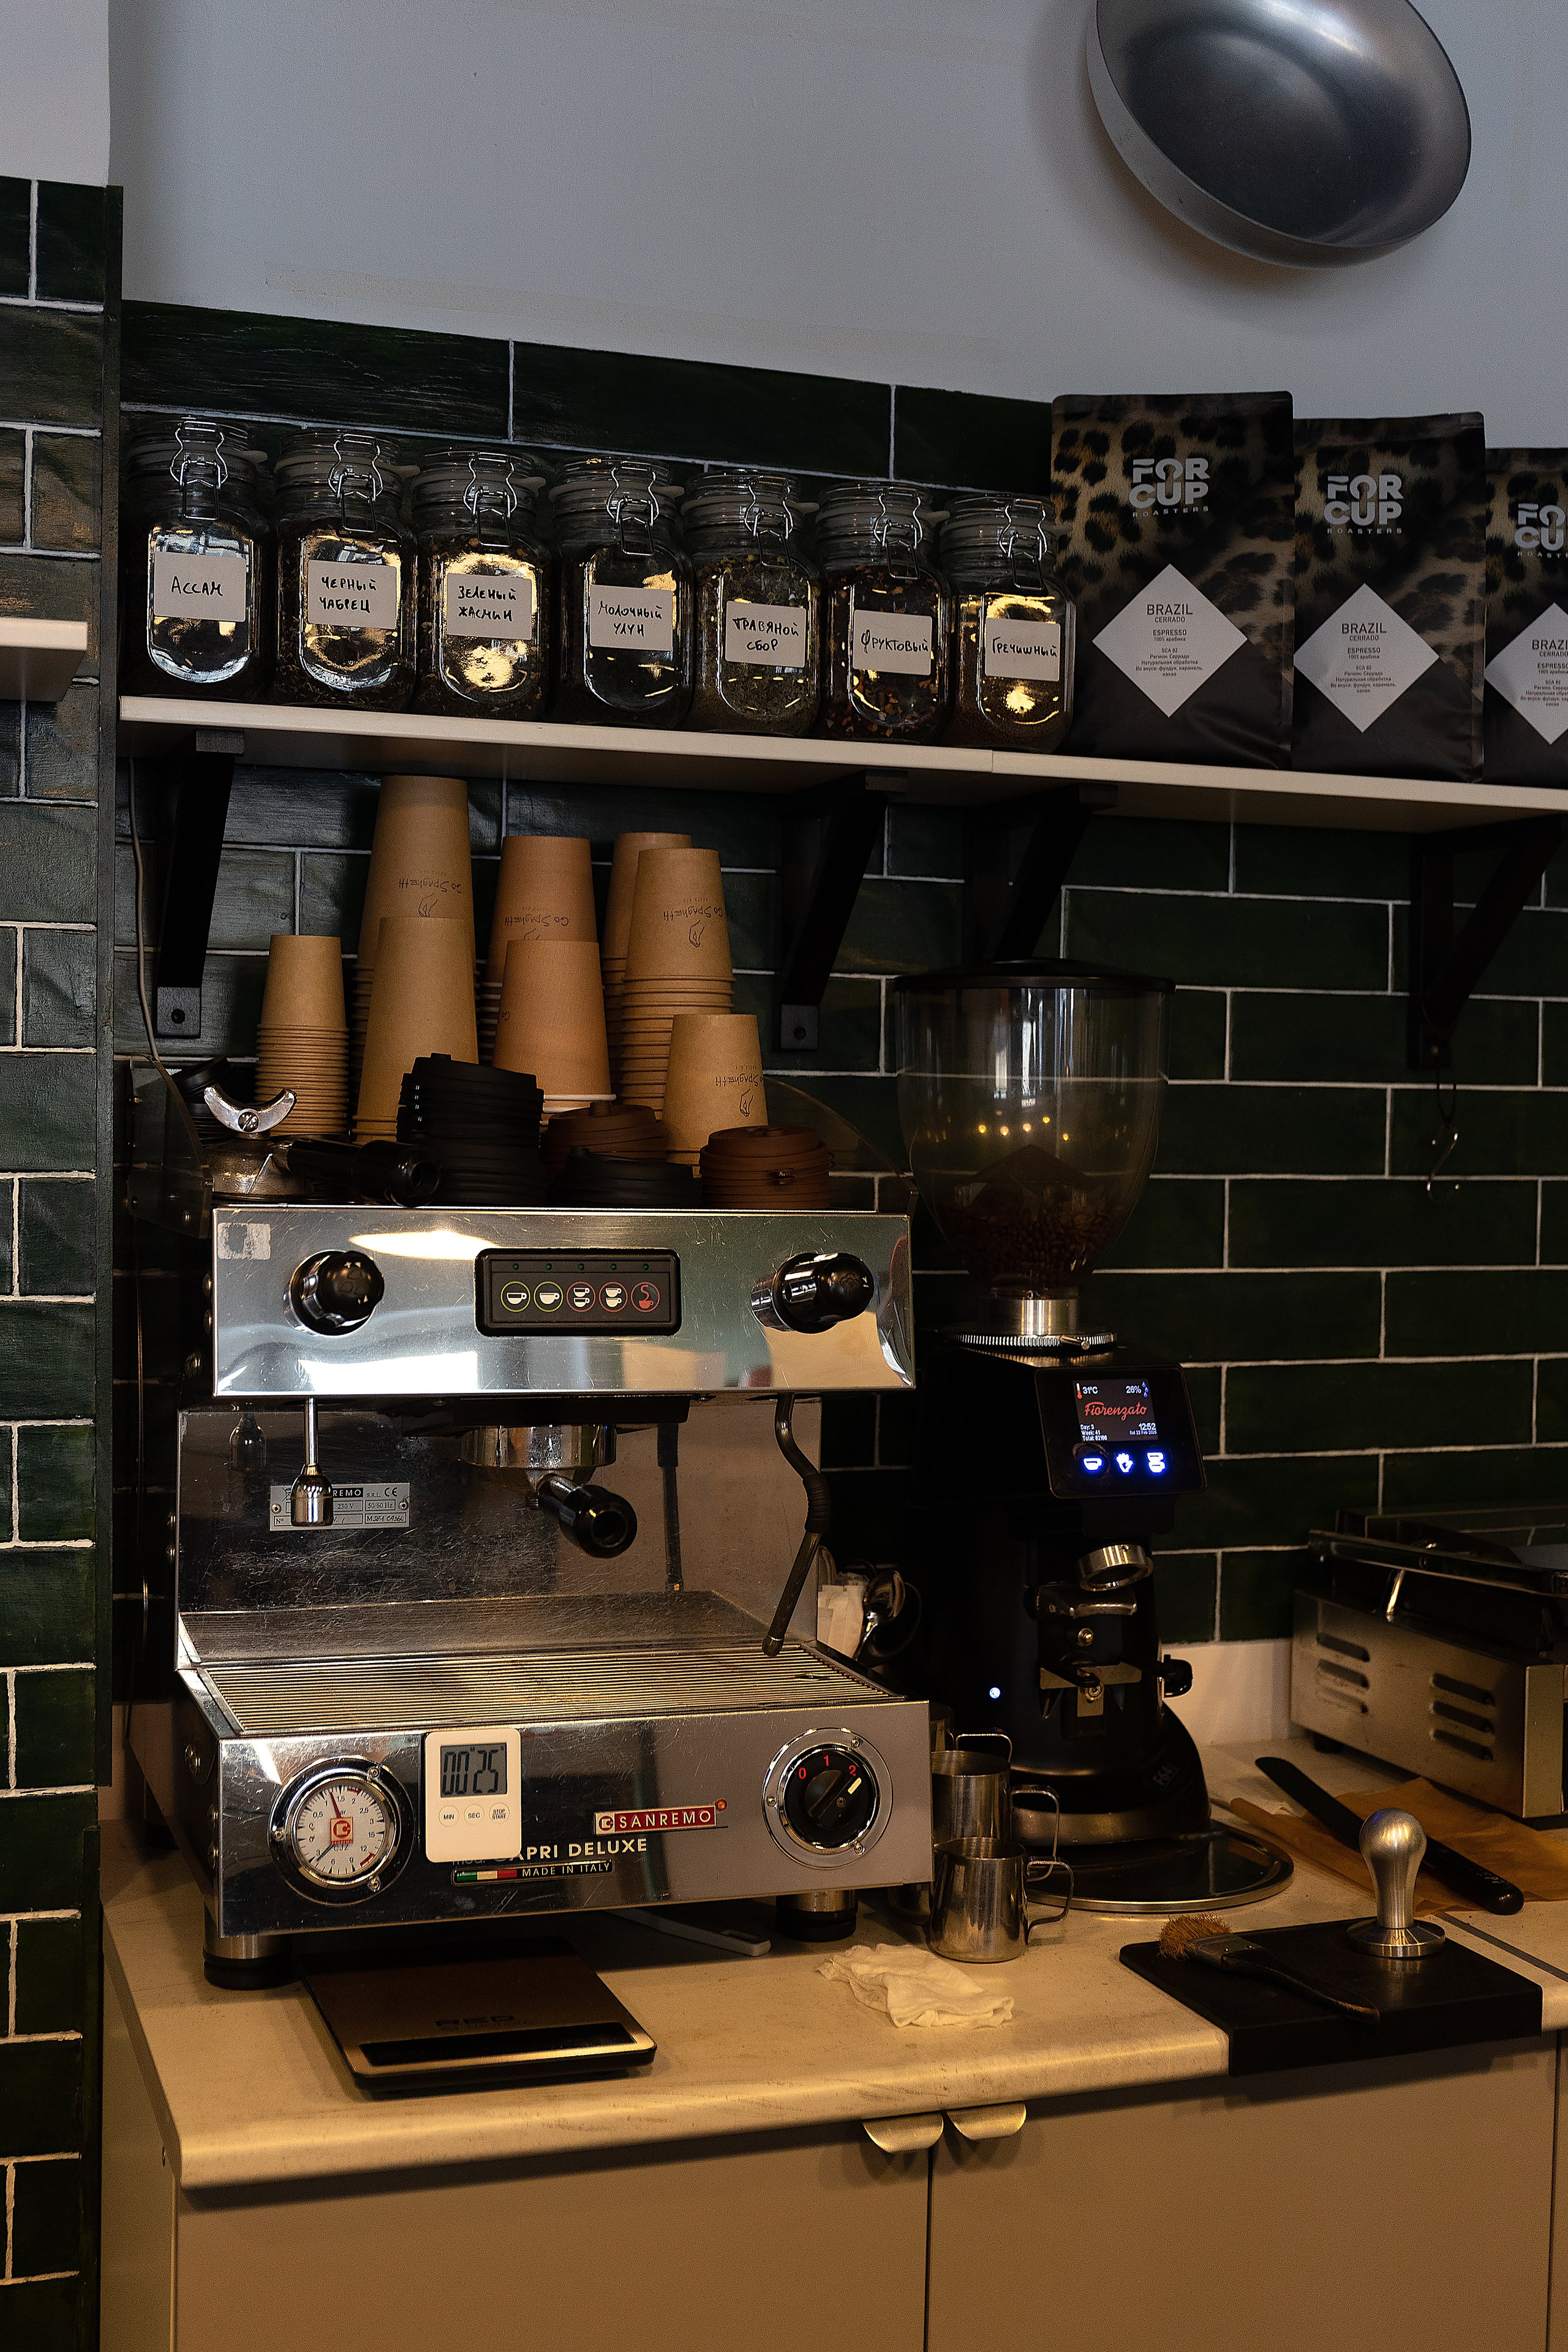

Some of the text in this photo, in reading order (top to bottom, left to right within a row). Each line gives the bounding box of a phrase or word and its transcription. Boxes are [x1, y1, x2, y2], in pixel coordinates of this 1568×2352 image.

[1133, 458, 1210, 483] FOR
[1128, 481, 1208, 508] CUP
[1327, 474, 1404, 500] FOR
[1133, 505, 1209, 518] ROASTERS
[1323, 500, 1402, 526] CUP
[1518, 503, 1568, 526] FO
[1513, 526, 1568, 551] CU
[1147, 603, 1193, 616] BRAZIL
[1341, 622, 1387, 634] BRAZIL
[1085, 1401, 1147, 1421] Fiorenzato
[1139, 1422, 1156, 1431] 12:52
[823, 1754, 829, 1766] 1
[798, 1767, 807, 1779] 0
[848, 1765, 856, 1776] 2
[619, 1810, 711, 1829] SANREMO
[494, 1845, 558, 1861] PRI
[568, 1838, 647, 1857] DELUXE
[522, 1863, 610, 1877] MADE IN ITALY
